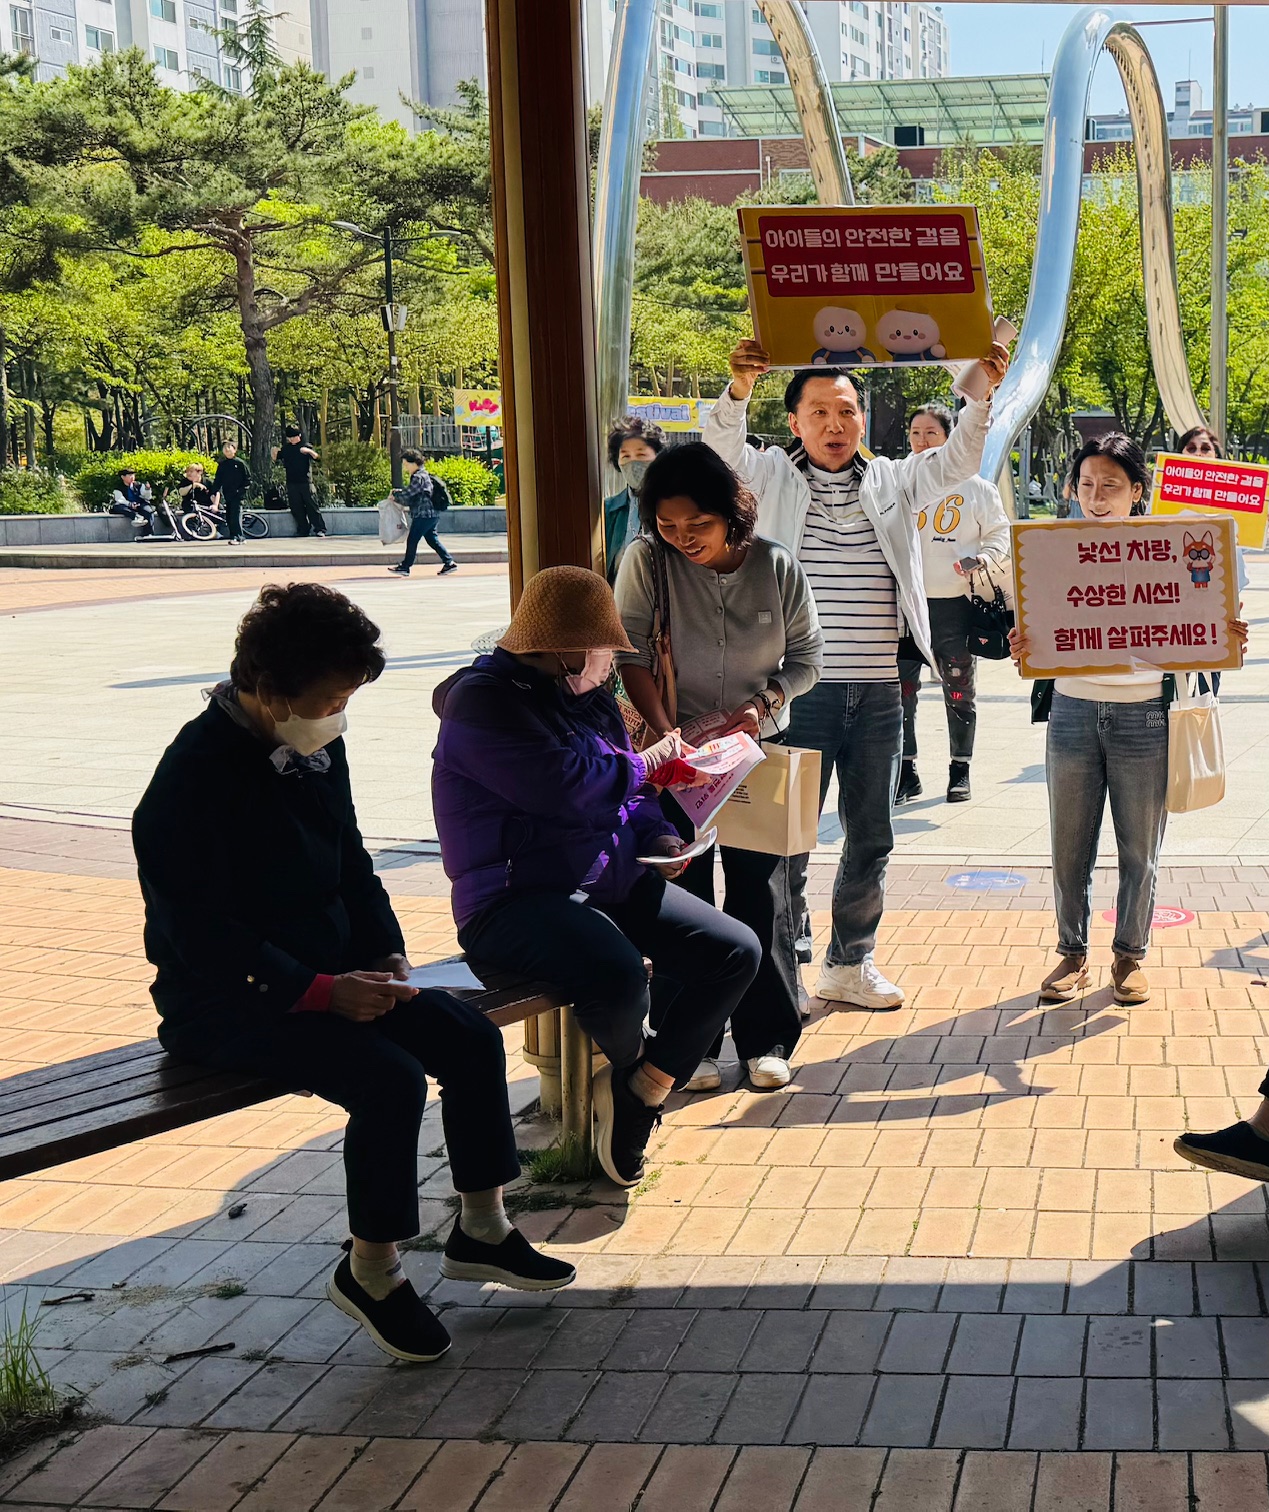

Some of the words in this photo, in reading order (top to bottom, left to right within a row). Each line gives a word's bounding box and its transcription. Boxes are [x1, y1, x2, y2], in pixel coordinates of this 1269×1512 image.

[765, 229, 841, 248] 아이들의
[845, 227, 912, 247] 안전한
[916, 227, 961, 246] 걸음
[771, 264, 828, 283] 우리가
[831, 263, 869, 282] 함께
[874, 262, 965, 283] 만들어요
[627, 404, 690, 421] estival
[1165, 466, 1203, 480] 아이들의
[1204, 470, 1240, 485] 안전한
[1240, 474, 1264, 488] 걸음
[1163, 483, 1192, 497] 우리가
[1192, 487, 1213, 500] 함께
[1213, 489, 1261, 506] 만들어요
[1077, 541, 1121, 564] 낯선
[1127, 539, 1178, 563] 차량,
[1066, 584, 1126, 607] 수상한
[1132, 582, 1180, 604] 시선!
[1053, 627, 1103, 652] 함께
[1107, 623, 1217, 649] 살펴주세요!
